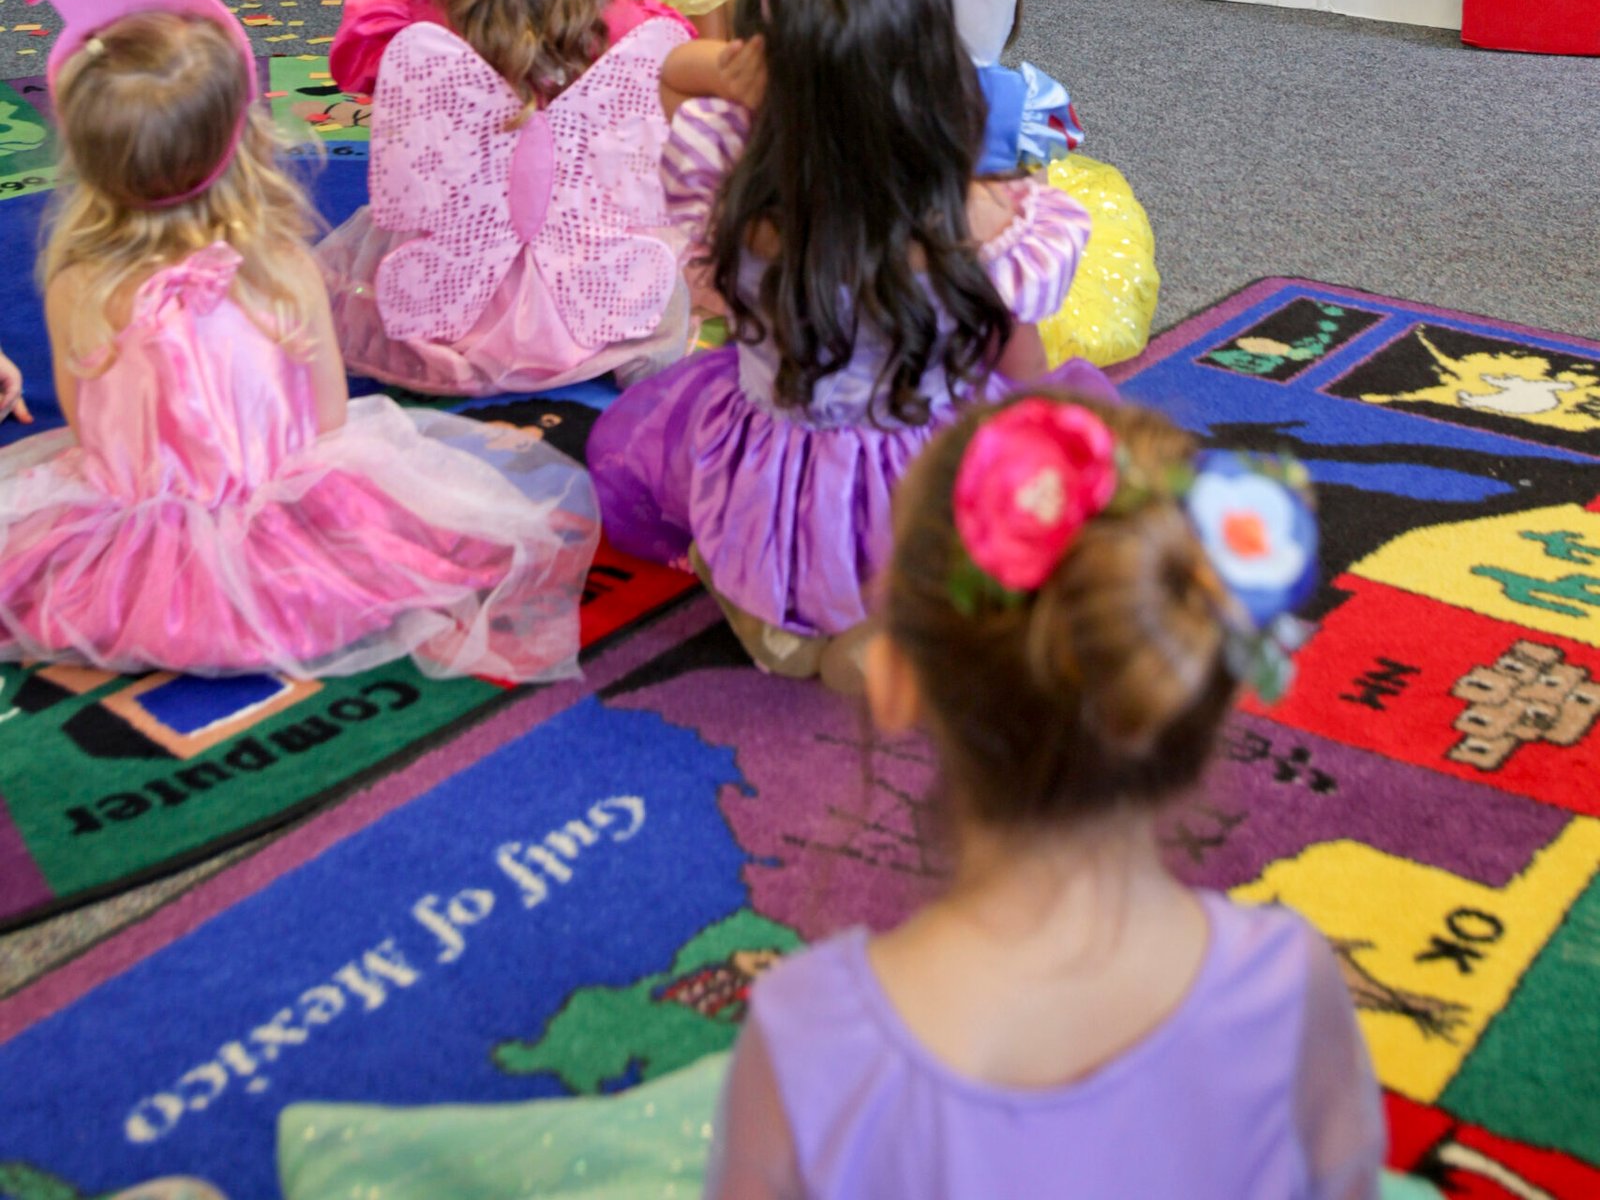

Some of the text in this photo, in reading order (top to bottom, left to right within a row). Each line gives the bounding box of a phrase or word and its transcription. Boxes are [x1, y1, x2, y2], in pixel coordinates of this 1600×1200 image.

[1338, 657, 1421, 712] NM
[65, 680, 421, 836] Computer
[124, 795, 646, 1143] Gulf of Mexico
[1414, 906, 1505, 974] OK
